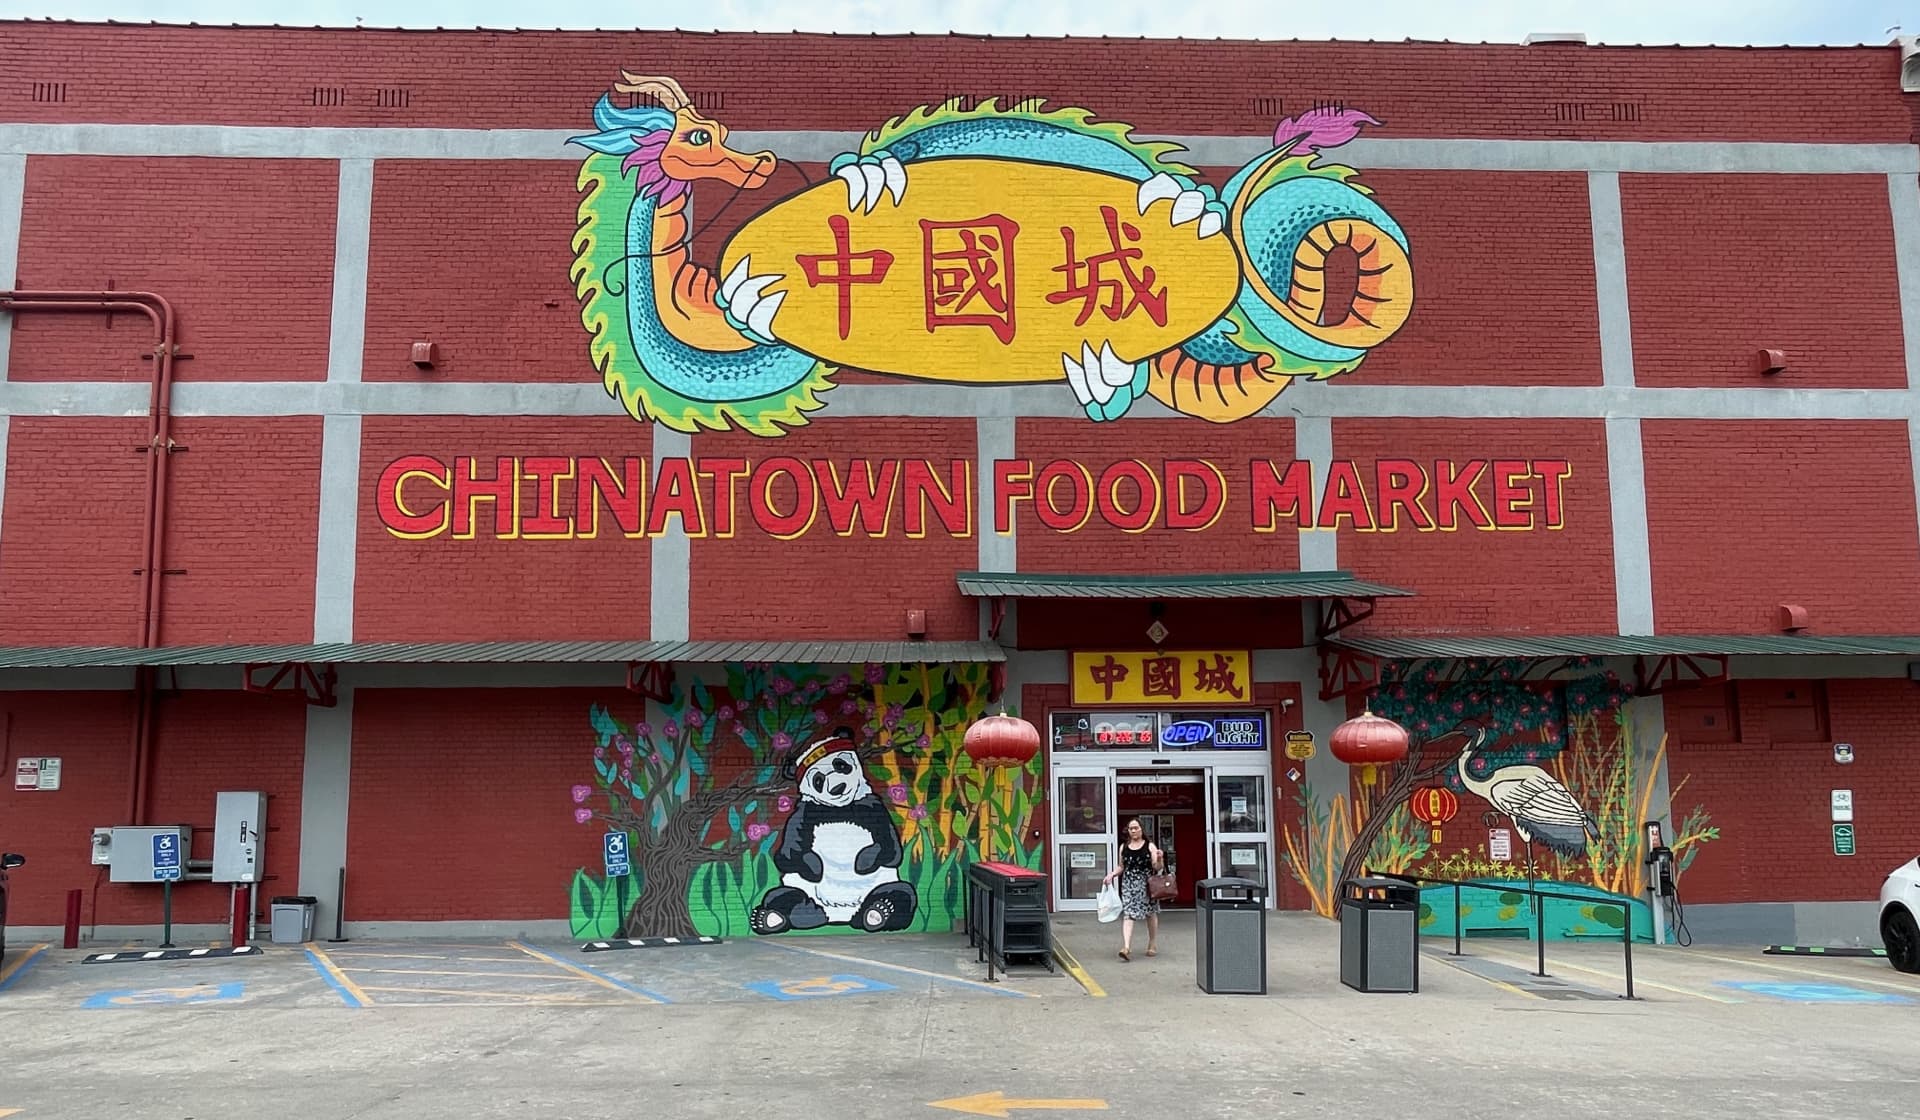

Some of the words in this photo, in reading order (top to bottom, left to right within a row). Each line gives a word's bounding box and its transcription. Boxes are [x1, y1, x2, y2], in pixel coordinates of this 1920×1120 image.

[795, 206, 1169, 345] 中國城
[375, 454, 973, 541] CHINATOWN
[993, 459, 1227, 534] FOOD
[1251, 459, 1572, 533] MARKET
[1090, 653, 1243, 700] 中國城
[1164, 725, 1208, 741] OPEN
[1221, 721, 1253, 733] BUD
[1215, 732, 1259, 744] LIGHT
[1127, 785, 1172, 794] MARKET
